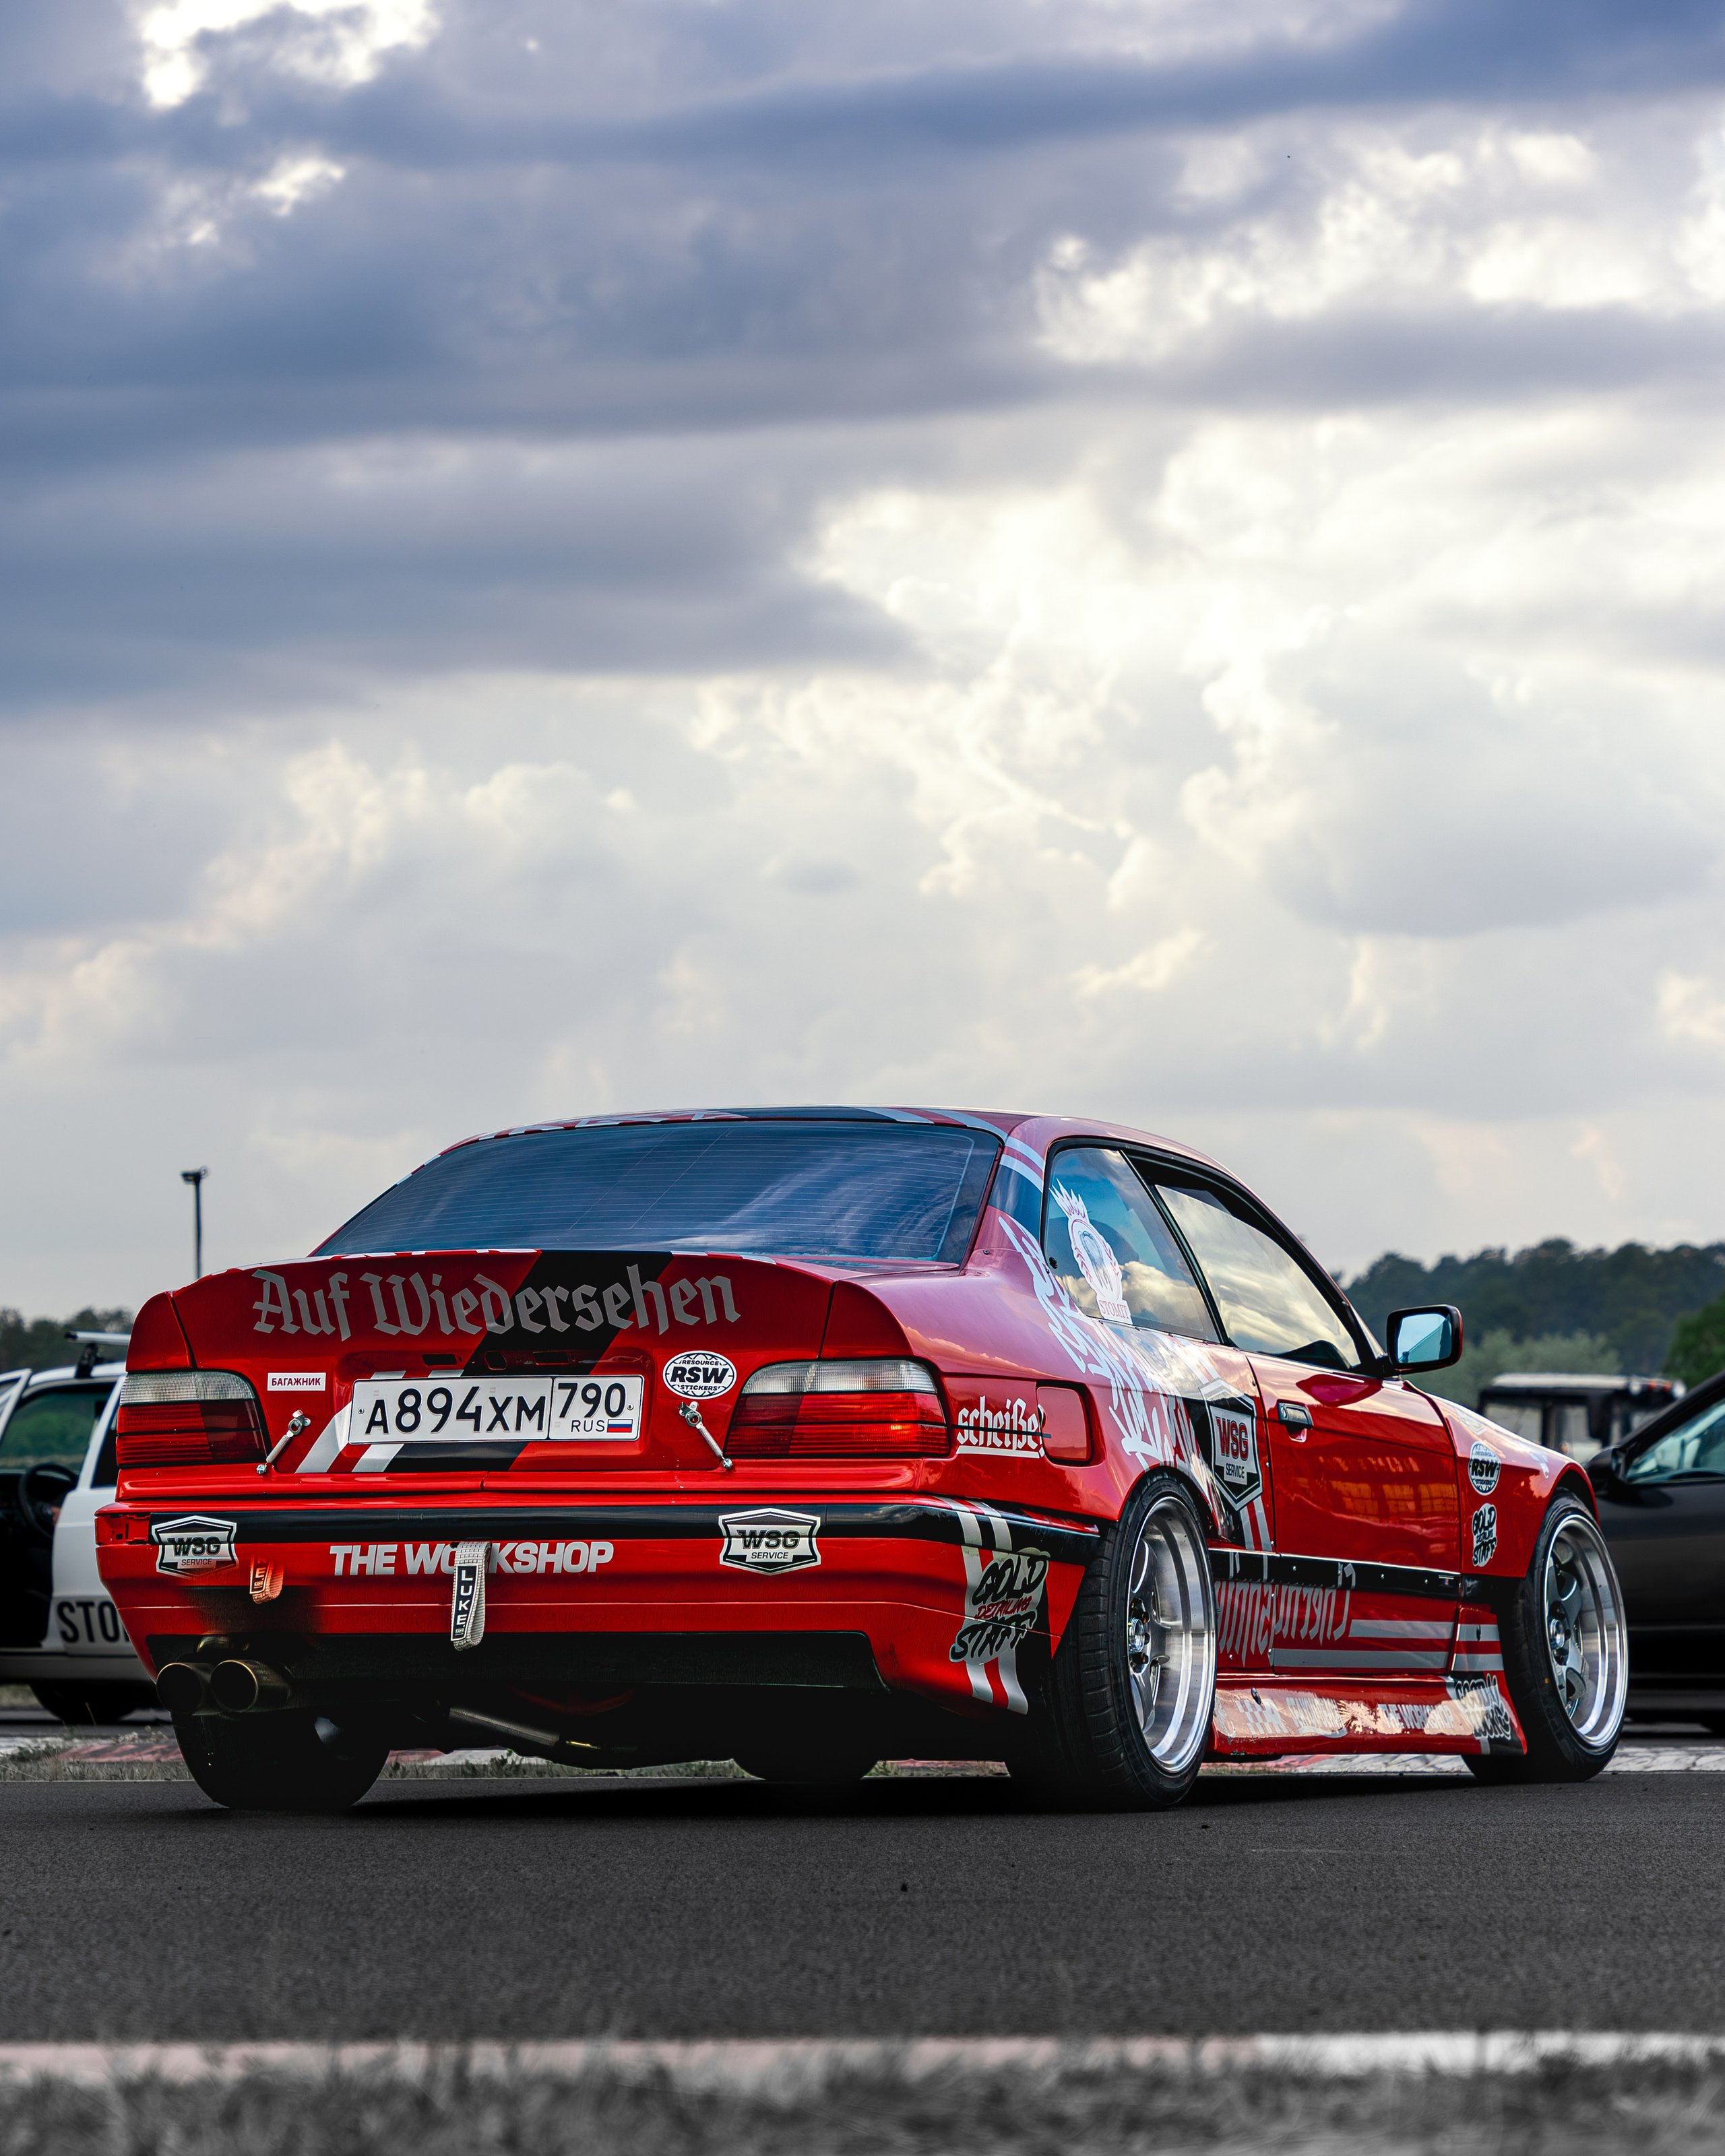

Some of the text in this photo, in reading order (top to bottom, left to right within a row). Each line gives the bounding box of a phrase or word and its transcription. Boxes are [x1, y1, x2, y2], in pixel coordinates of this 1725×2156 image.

[251, 1263, 741, 1341] Auf Wiedersehen
[1098, 1299, 1130, 1319] STOMIT
[271, 1377, 321, 1387] БАГАЖНИК
[670, 1366, 730, 1385] RSW
[557, 1383, 626, 1419] 790
[570, 1419, 606, 1433] RUS
[1215, 1416, 1249, 1461] WSG
[1225, 1462, 1245, 1479] SERVICE
[1471, 1458, 1497, 1478] RSW
[1472, 1506, 1497, 1535] GOLD
[166, 1536, 221, 1557] WSG
[736, 1529, 801, 1550] WSG
[181, 1558, 212, 1566] SERVICE
[330, 1544, 398, 1576] THE
[971, 1554, 1048, 1606] GOLD
[975, 1595, 1033, 1618] DETAILING
[57, 1601, 130, 1643] STO
[950, 1610, 1036, 1660] STAFF
[1377, 1704, 1405, 1729] THE
